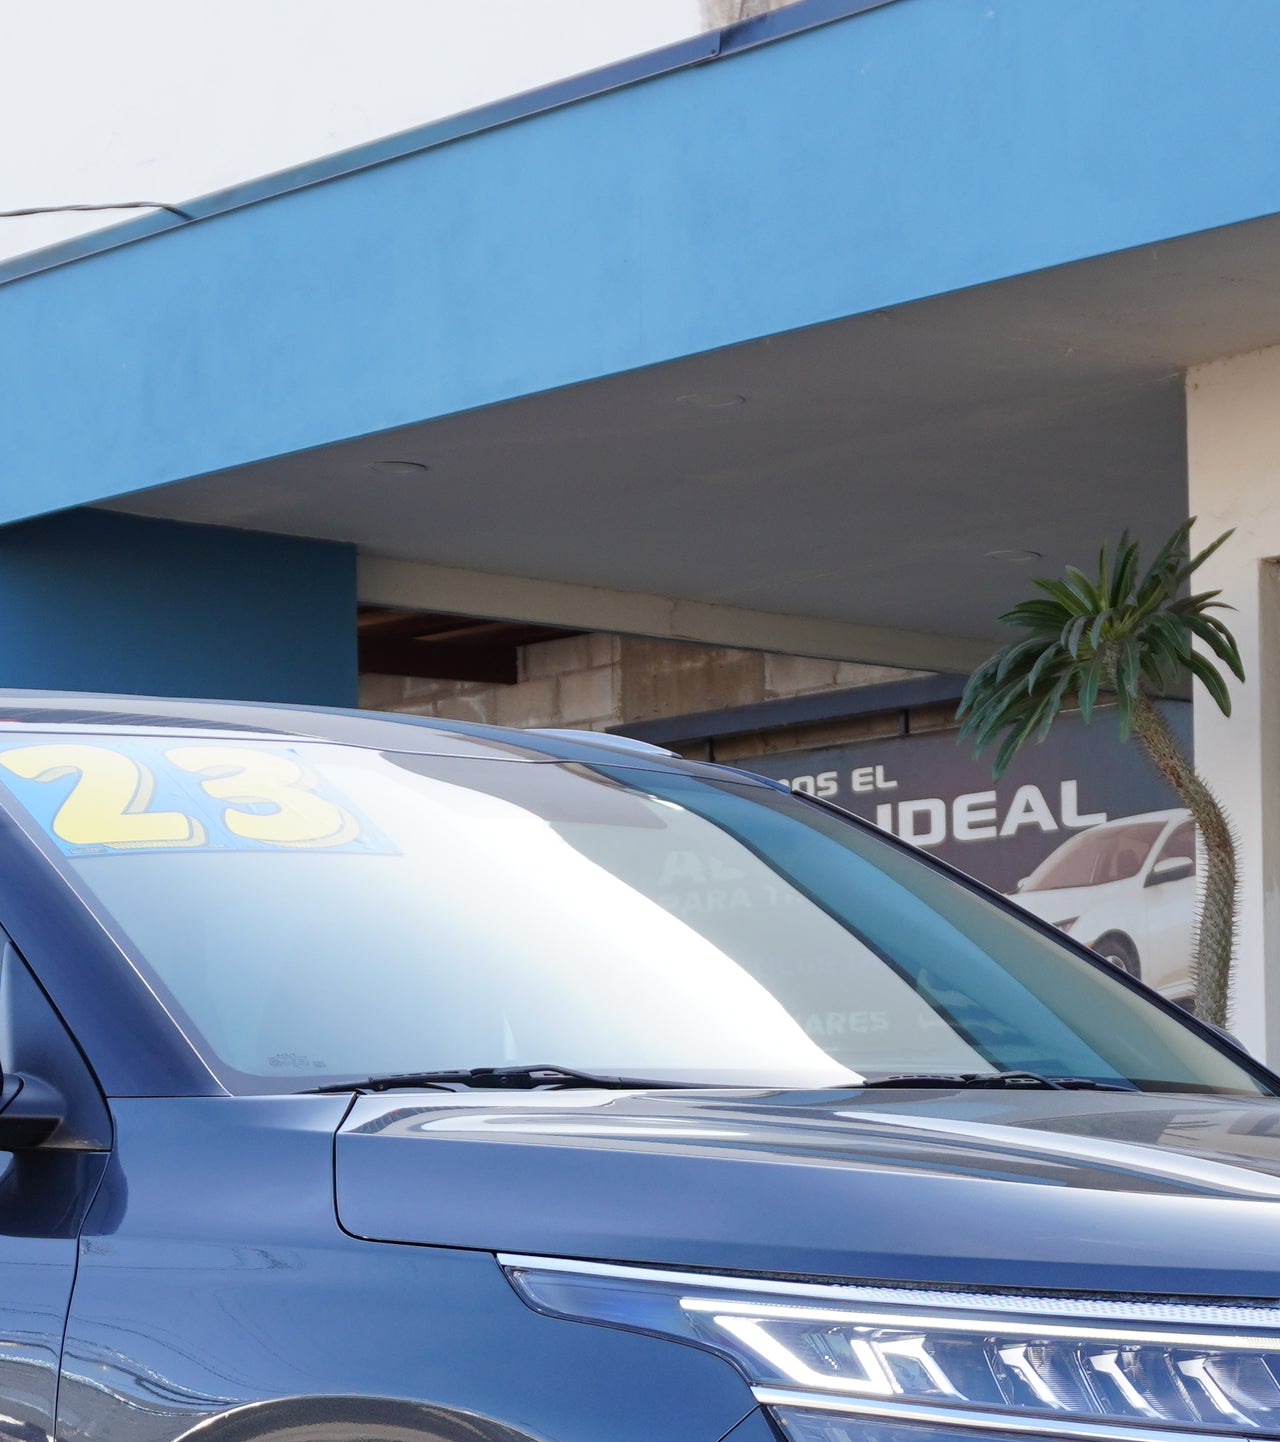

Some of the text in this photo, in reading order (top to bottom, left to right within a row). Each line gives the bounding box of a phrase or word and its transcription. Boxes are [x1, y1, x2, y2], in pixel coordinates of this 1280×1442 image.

[778, 764, 899, 798] OS EL
[875, 778, 1108, 847] IDEAL
